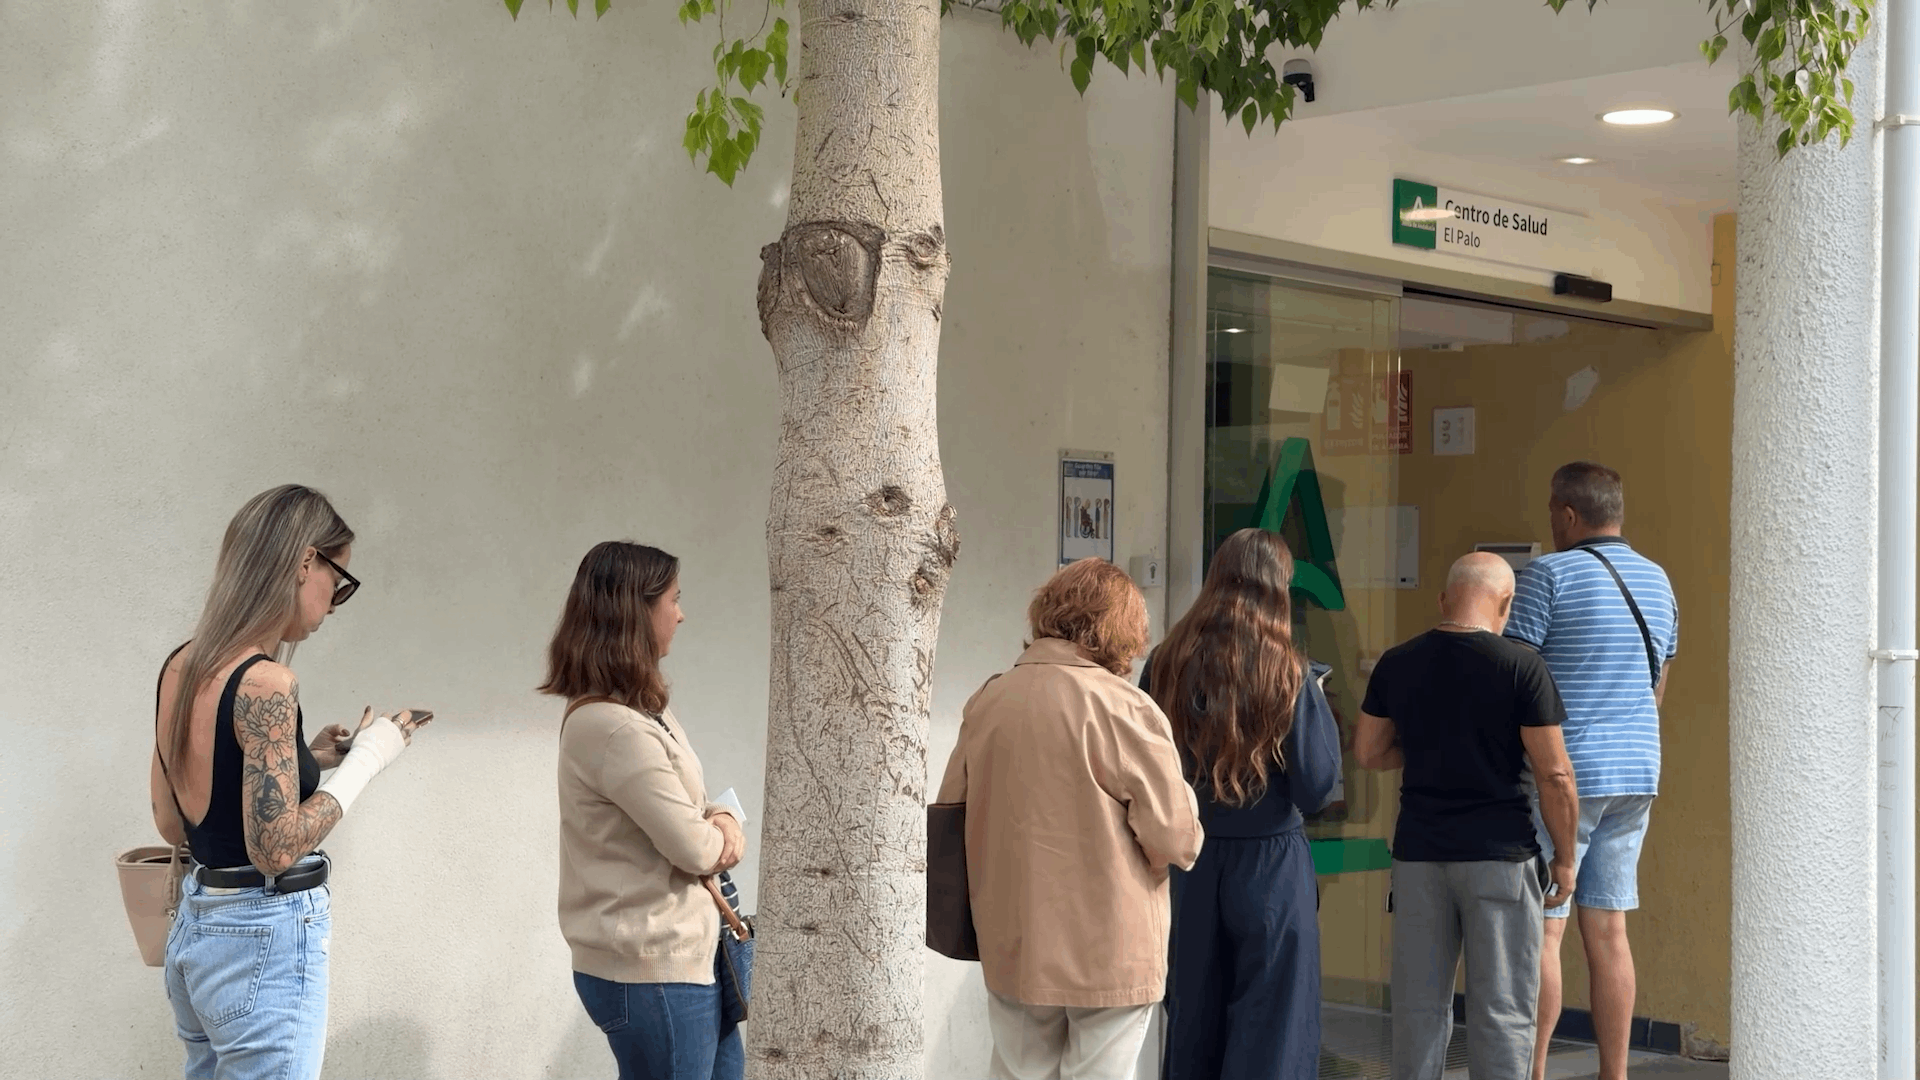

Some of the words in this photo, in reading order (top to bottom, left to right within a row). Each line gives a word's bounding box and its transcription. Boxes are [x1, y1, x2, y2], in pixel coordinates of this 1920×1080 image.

[1445, 200, 1489, 224] Centro
[1493, 209, 1509, 228] de
[1512, 213, 1547, 236] Salud
[1444, 227, 1454, 243] El
[1457, 230, 1480, 248] Palo
